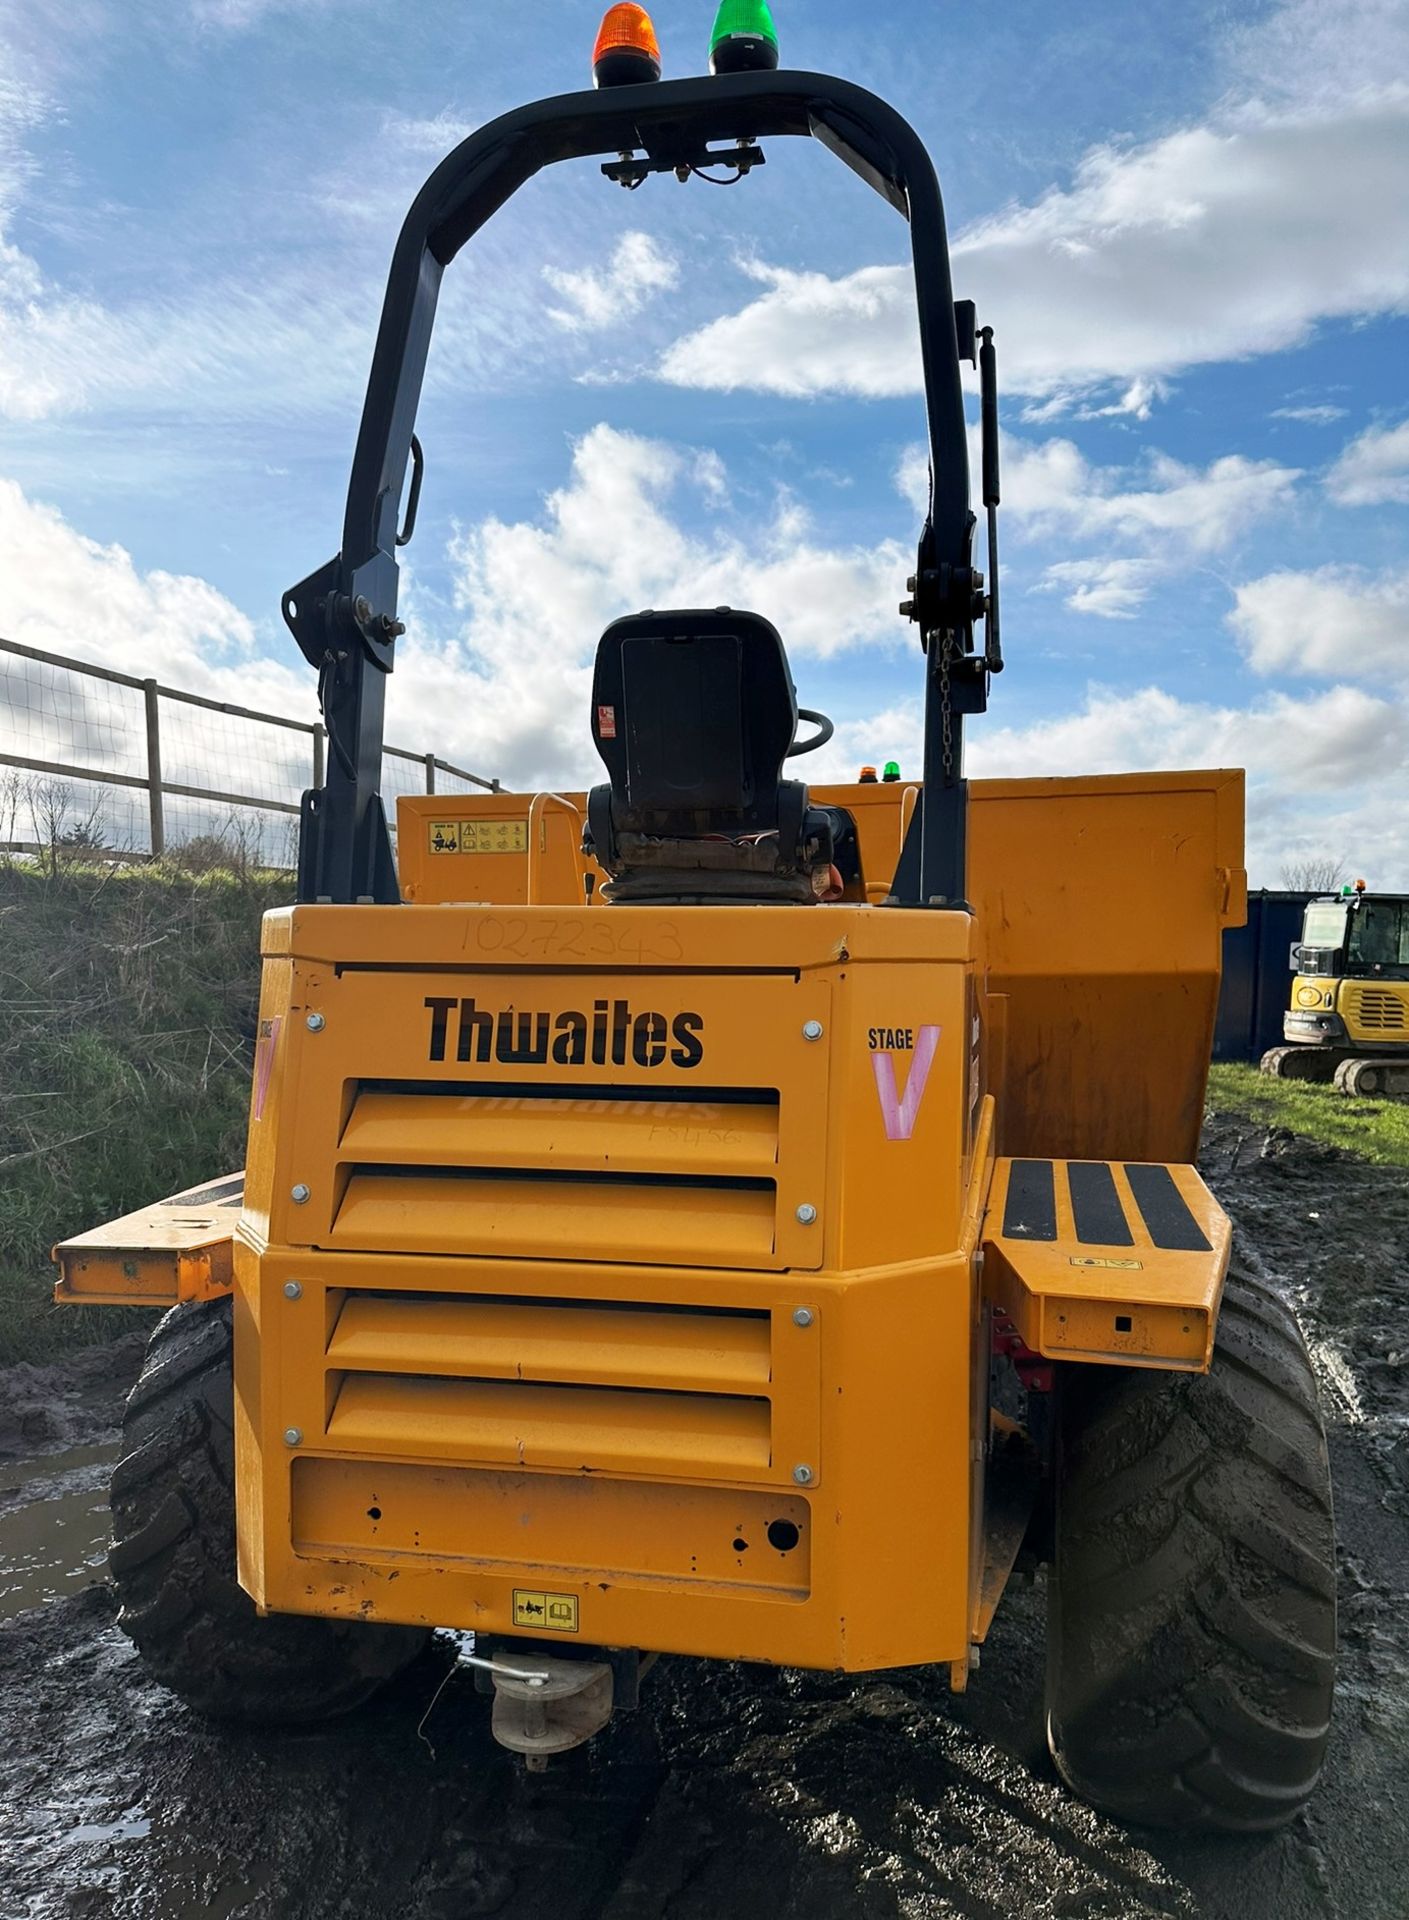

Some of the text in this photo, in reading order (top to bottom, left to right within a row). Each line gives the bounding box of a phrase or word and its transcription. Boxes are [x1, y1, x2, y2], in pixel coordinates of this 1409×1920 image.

[462, 915, 684, 964] 10272343
[425, 997, 703, 1067] Thwaites
[868, 1028, 913, 1049] STAGE
[870, 1025, 942, 1140] V
